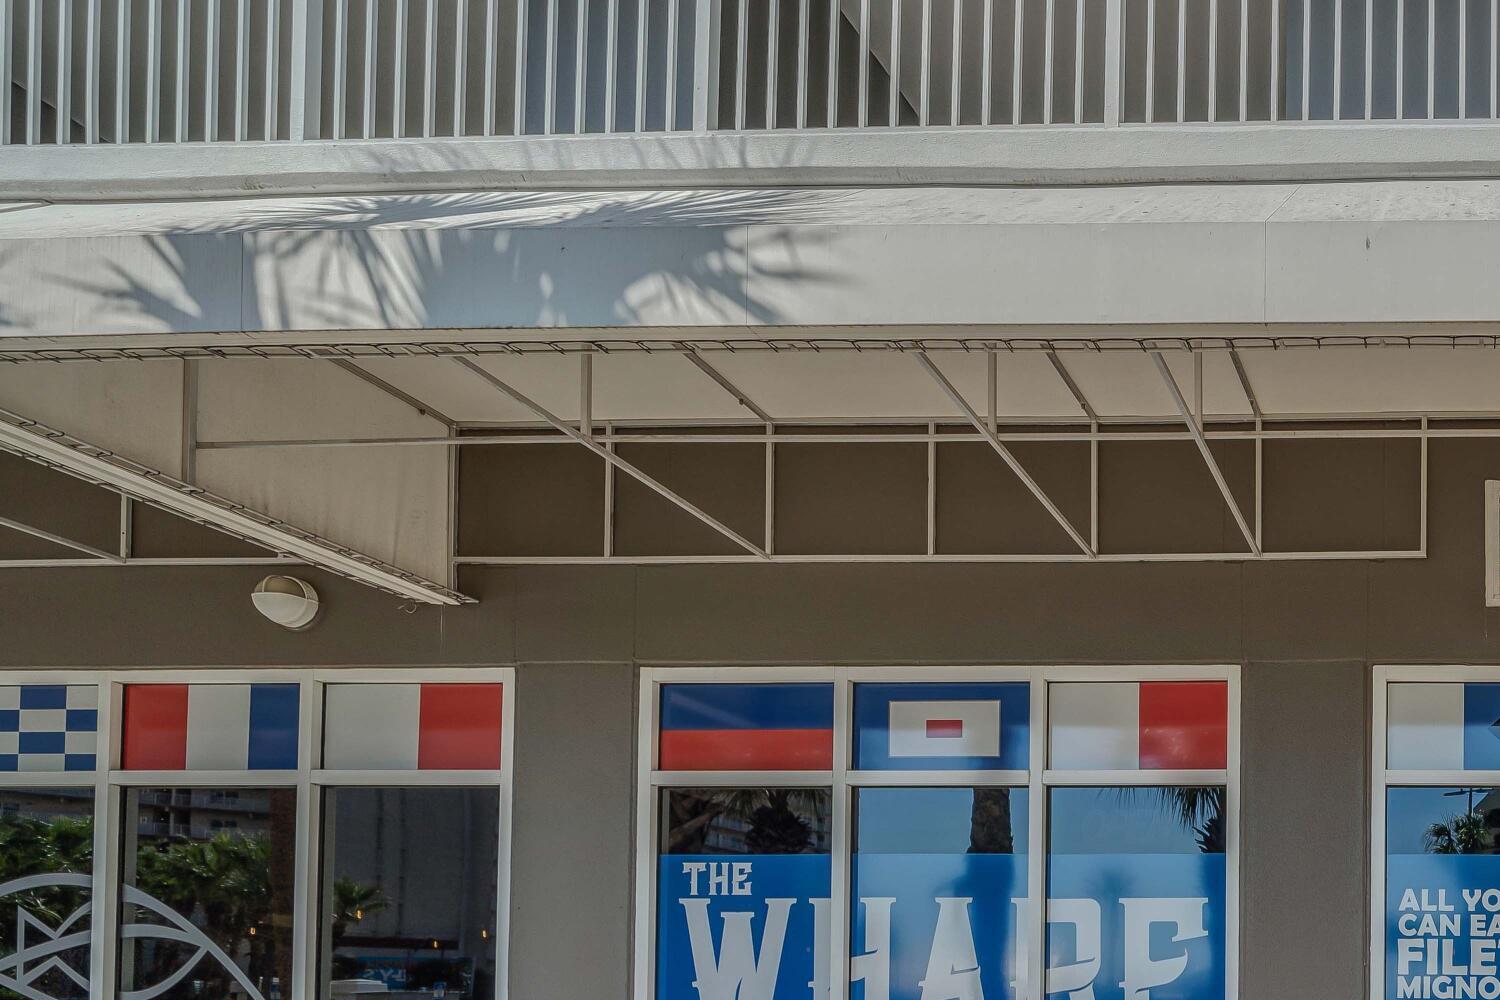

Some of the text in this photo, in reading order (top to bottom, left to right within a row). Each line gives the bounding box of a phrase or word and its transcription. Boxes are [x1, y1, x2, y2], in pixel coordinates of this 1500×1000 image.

[682, 862, 753, 896] THE
[1398, 888, 1455, 912] ALL
[1398, 914, 1461, 937] CAN
